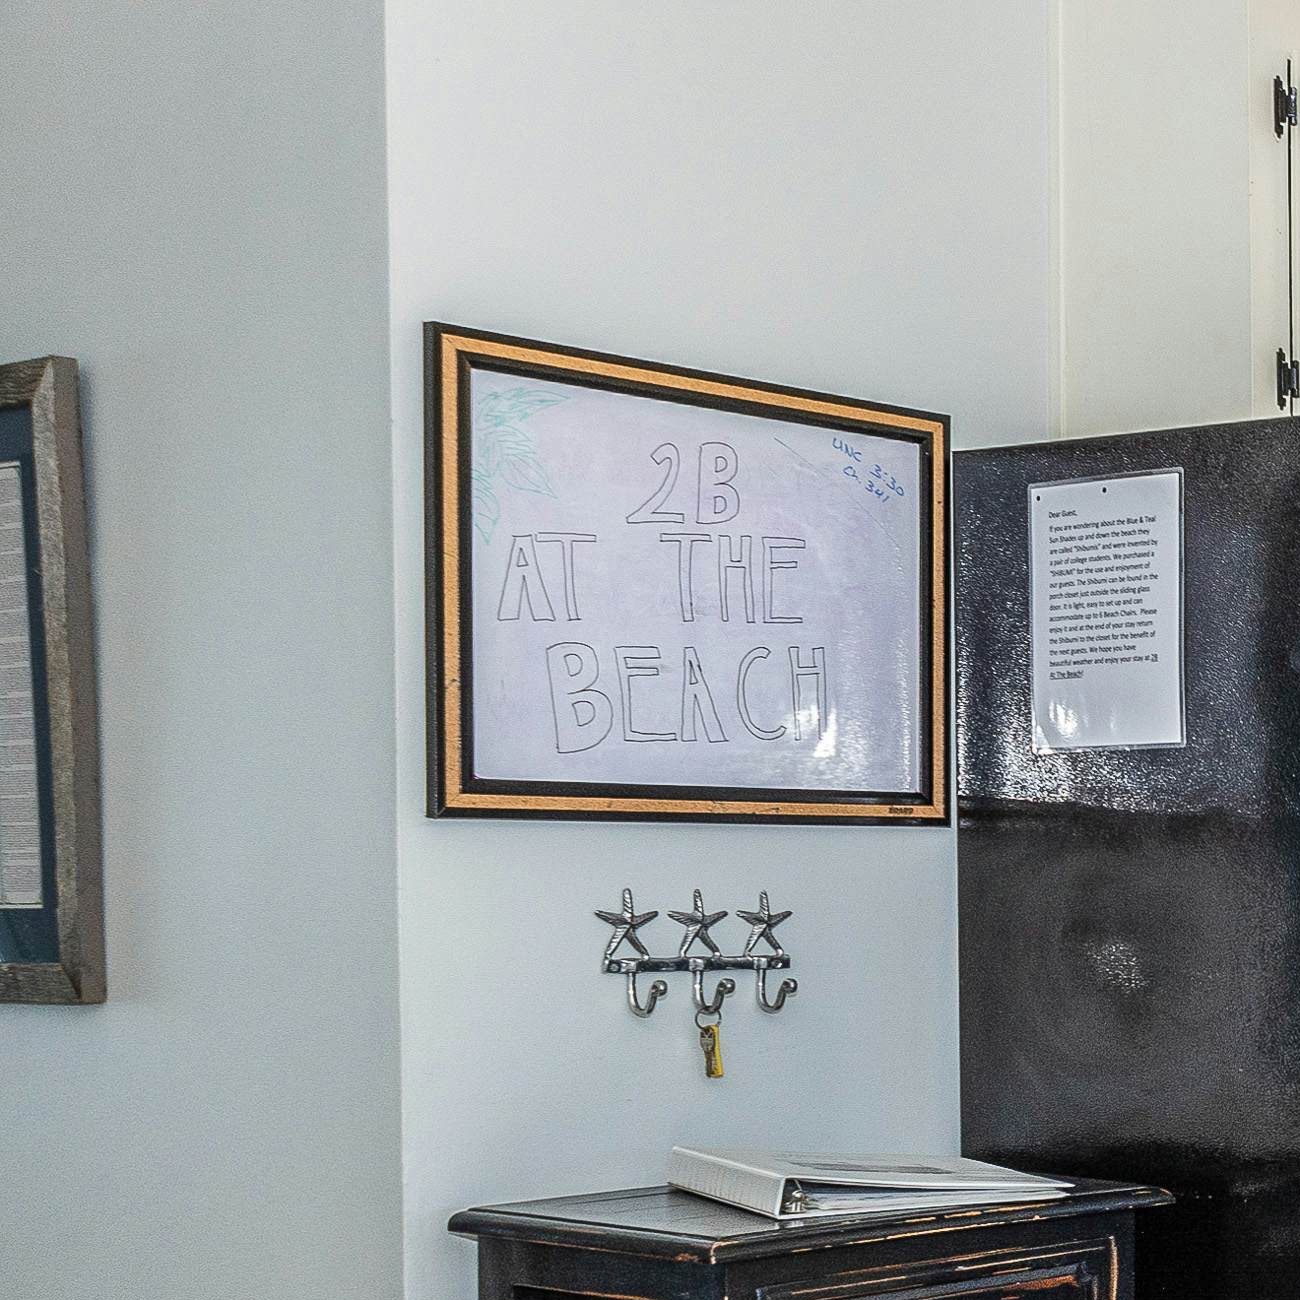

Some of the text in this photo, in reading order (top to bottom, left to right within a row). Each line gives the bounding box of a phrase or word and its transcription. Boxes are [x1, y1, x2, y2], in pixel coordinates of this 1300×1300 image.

[626, 441, 741, 525] 2B
[832, 437, 905, 497] UNC 3:30
[865, 480, 890, 503] 341
[497, 531, 806, 624] AT THE
[545, 641, 830, 754] BEACH
